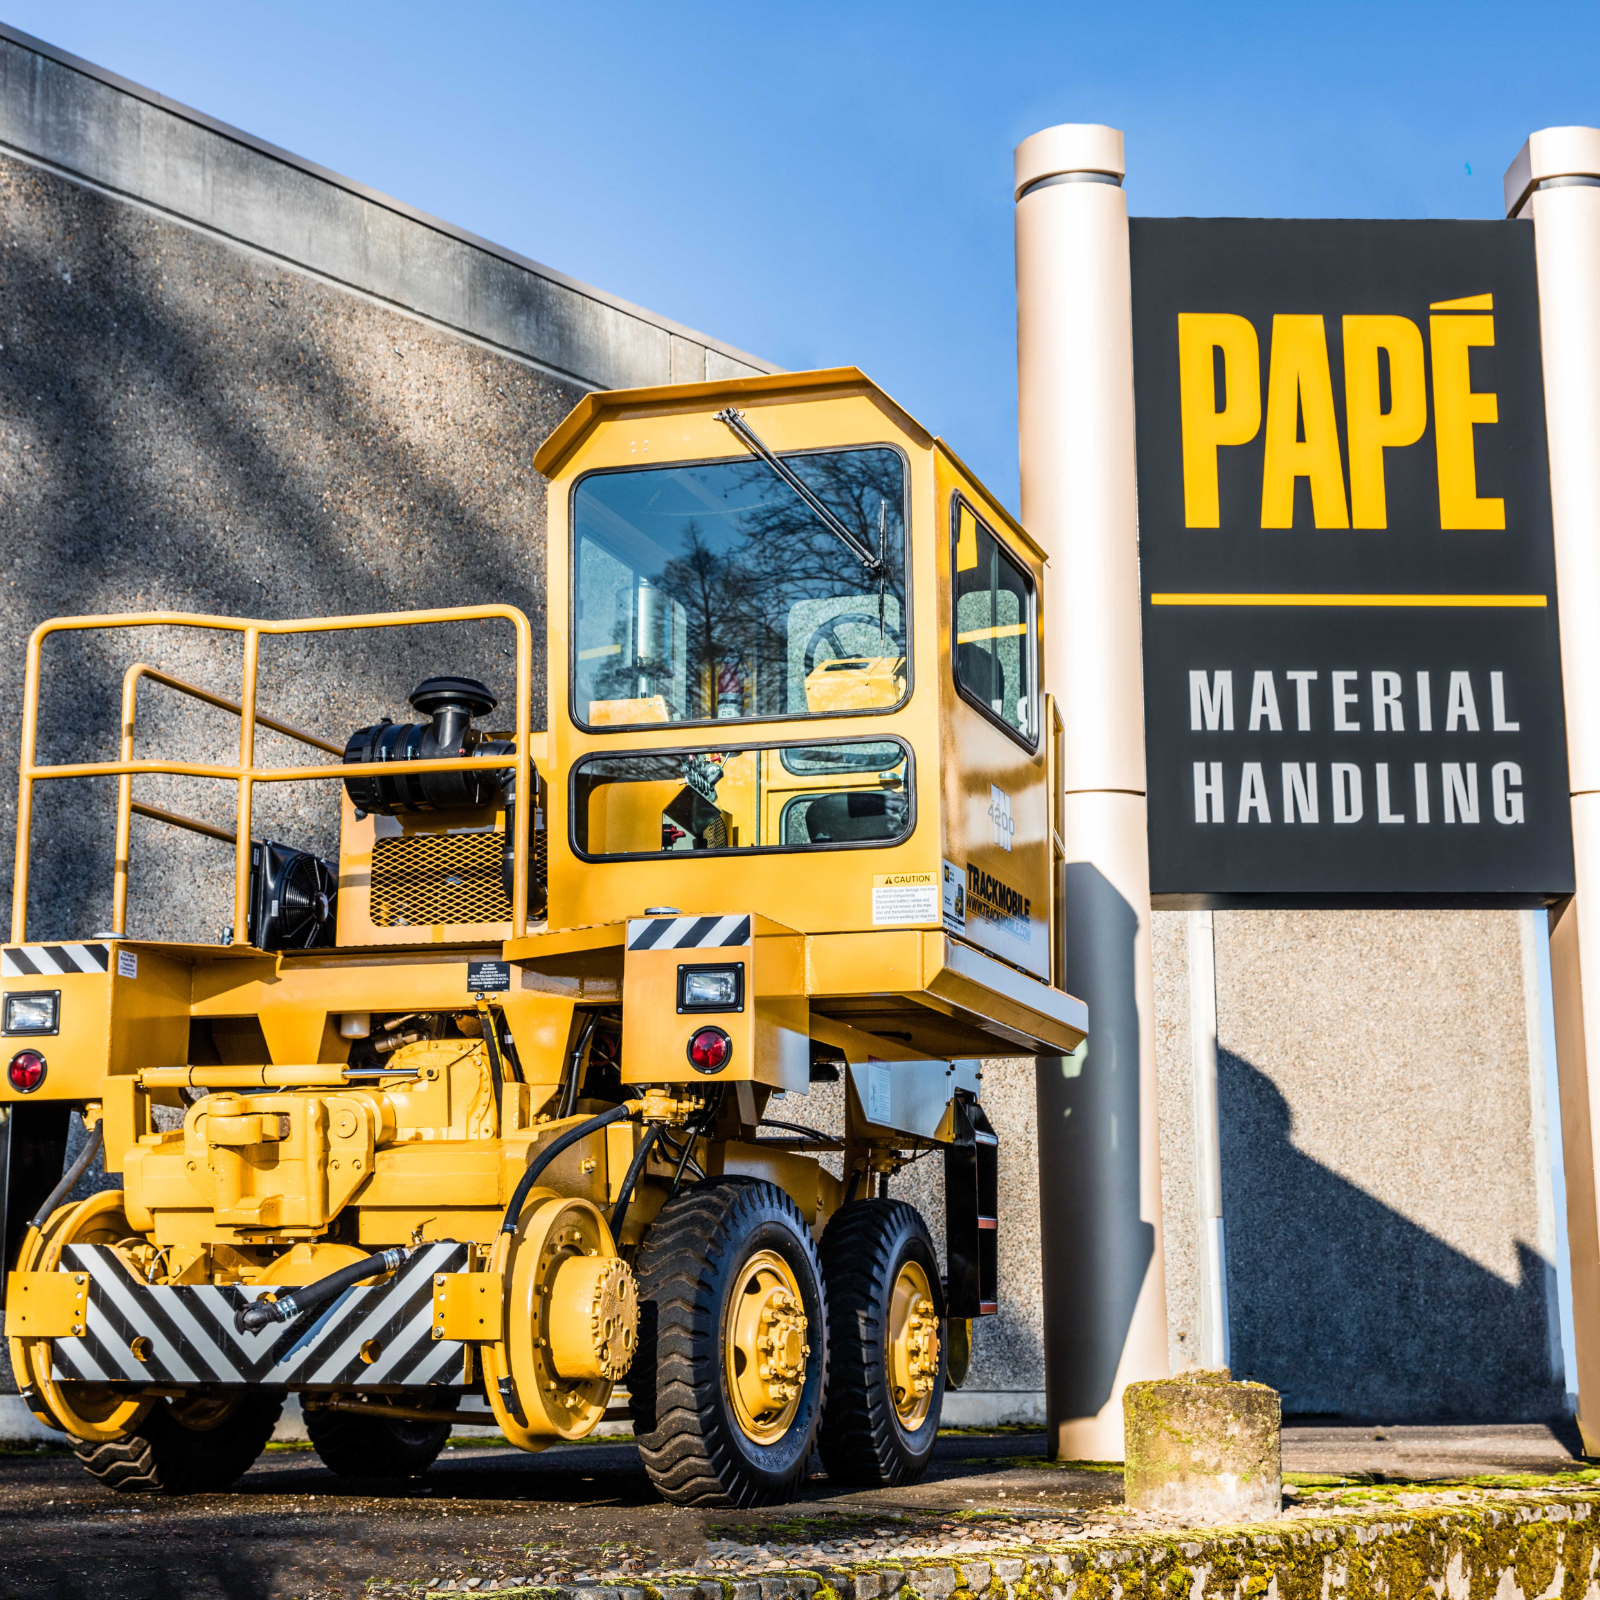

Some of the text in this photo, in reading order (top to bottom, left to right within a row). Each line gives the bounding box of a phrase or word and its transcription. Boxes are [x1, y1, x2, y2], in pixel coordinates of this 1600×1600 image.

[1178, 293, 1506, 530] PAPÉ
[1188, 669, 1520, 732] MATERIAL
[988, 803, 1015, 836] 4200
[1193, 761, 1525, 825] HANDLING
[894, 875, 930, 883] CAUTION
[966, 862, 1030, 925] TRACKMOBILE
